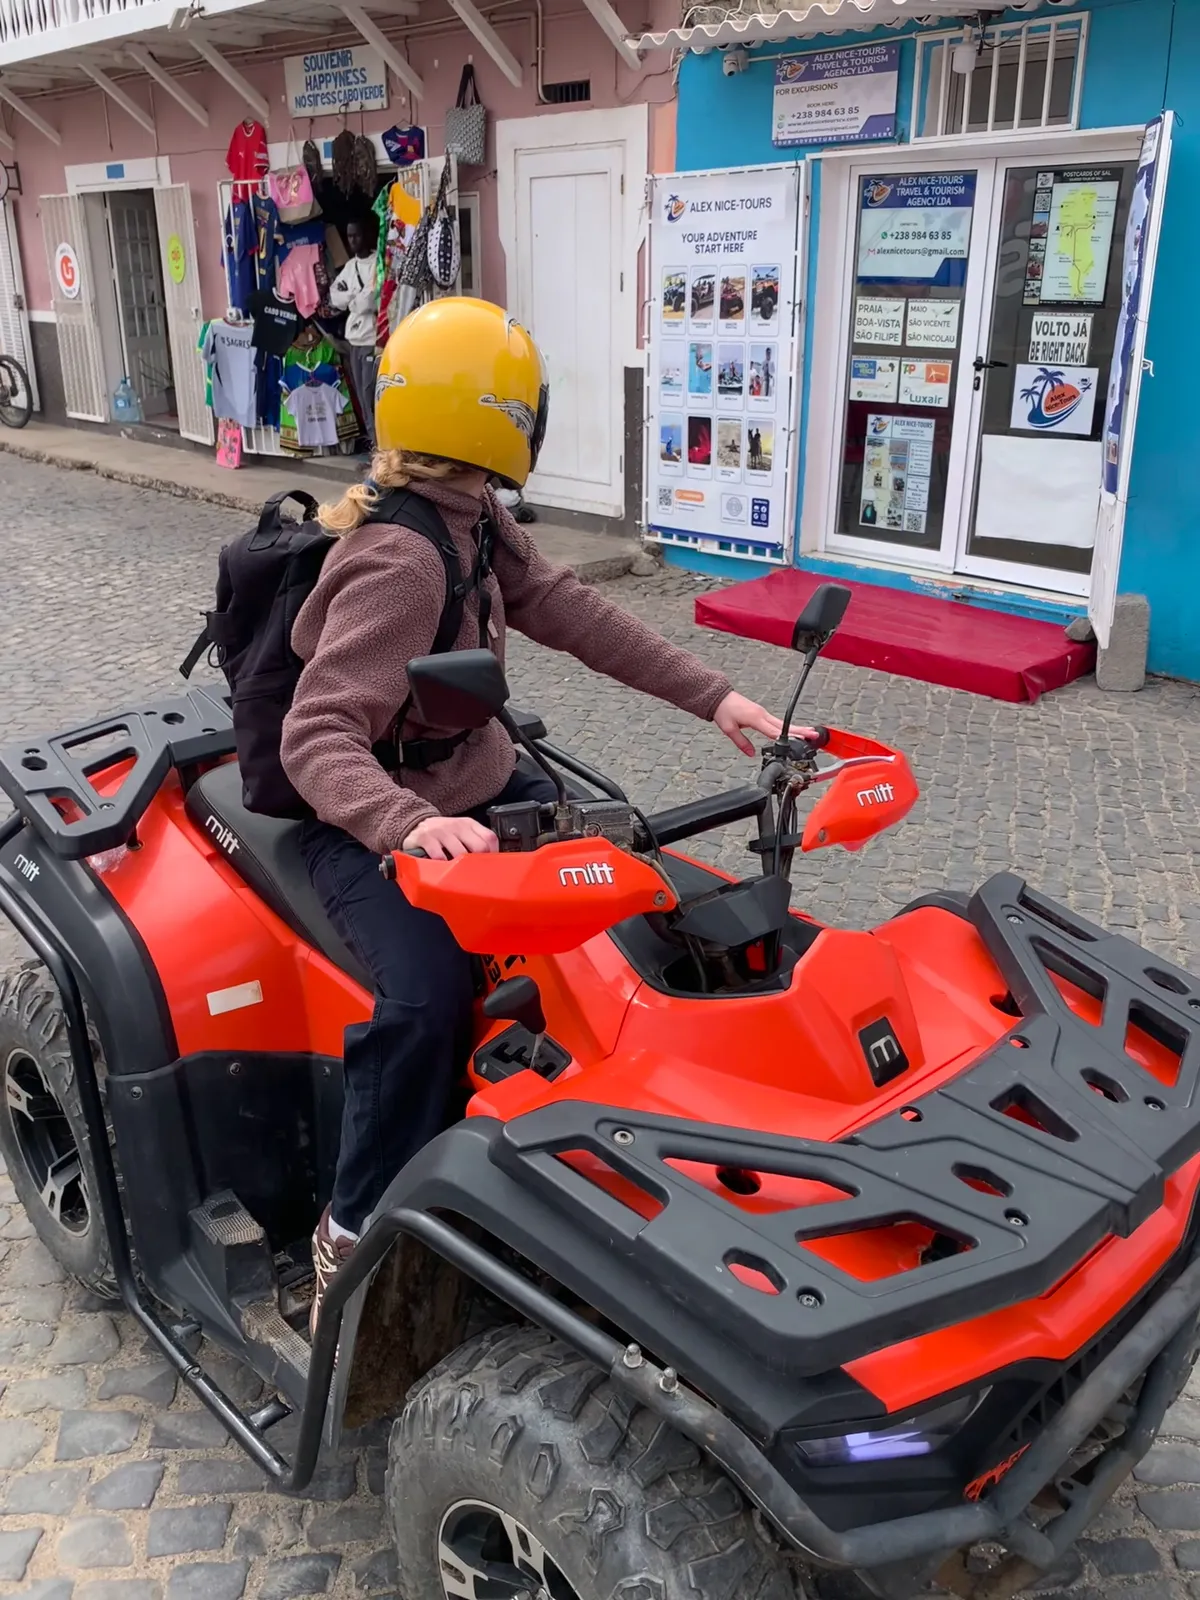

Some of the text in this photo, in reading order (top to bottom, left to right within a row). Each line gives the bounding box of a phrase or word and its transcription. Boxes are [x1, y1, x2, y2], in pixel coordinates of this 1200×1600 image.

[814, 46, 886, 62] ALEX NICE-TOURS
[303, 49, 353, 73] SOUVENIR
[812, 62, 840, 71] TRAVEL
[850, 55, 888, 66] TOURISM
[824, 65, 874, 78] AGENCY LDA
[305, 66, 367, 92] HAPPYNESS
[776, 82, 838, 96] FOR EXCURSIONS
[294, 95, 306, 109] NO
[337, 87, 358, 103] CABO
[359, 84, 384, 100] VERDE
[791, 106, 860, 120] +238 984 63 85
[795, 136, 837, 144] ADVENTURE
[899, 175, 964, 186] ALEX NICE-TOURS
[896, 186, 965, 196] TRAVEL & TOURISM
[690, 197, 772, 213] ALEX NICE-TOURS
[906, 197, 952, 206] AGENCY LDA
[681, 230, 758, 243] YOUR ADVENTURE
[890, 231, 952, 240] +238 984 63 85
[695, 242, 745, 254] START HERE
[876, 247, 965, 257] alexnicetours@gmail.com
[858, 304, 883, 314] PRAIA
[856, 317, 901, 328] BOA-VISTA
[908, 319, 951, 328] SÃO VICENTE
[1035, 319, 1087, 337] VOLTO JÁ
[855, 329, 899, 342] SÃO FILIPE
[907, 333, 955, 343] SÃO NICOLAU
[226, 338, 251, 349] SAGRES
[1030, 341, 1087, 364] BE RIGHT BACK
[909, 393, 943, 405] Luxair
[1045, 394, 1076, 411] Nice-Tours
[1050, 391, 1066, 403] Alex
[856, 782, 895, 807] mitt
[205, 814, 240, 855] mitt
[13, 853, 40, 882] mitt
[558, 861, 615, 887] mitt
